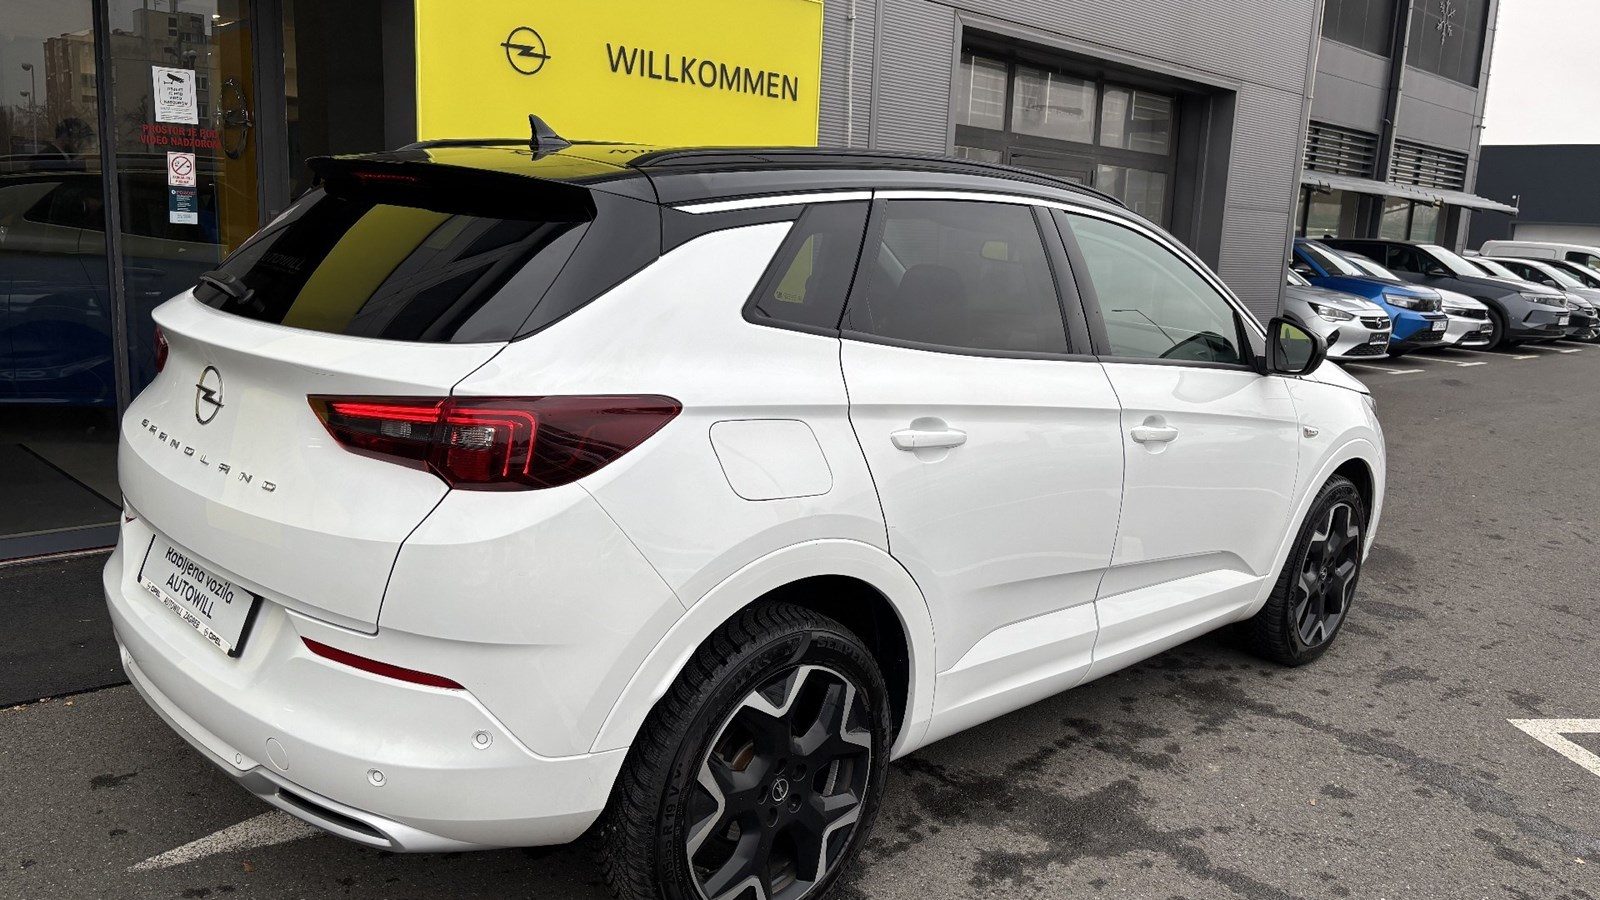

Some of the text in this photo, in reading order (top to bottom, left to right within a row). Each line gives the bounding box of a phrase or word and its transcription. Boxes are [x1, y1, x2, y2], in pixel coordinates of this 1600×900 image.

[606, 43, 798, 101] WILLKOMMEN
[140, 135, 168, 146] VIDEO
[142, 123, 185, 135] PROSTOR
[188, 127, 197, 137] JE
[141, 418, 277, 493] GRANDLAND
[165, 573, 213, 619] AUTOWILL
[206, 576, 234, 604] vozila
[150, 585, 221, 647] OPEL AUTOWILL ZAGREB OPEL
